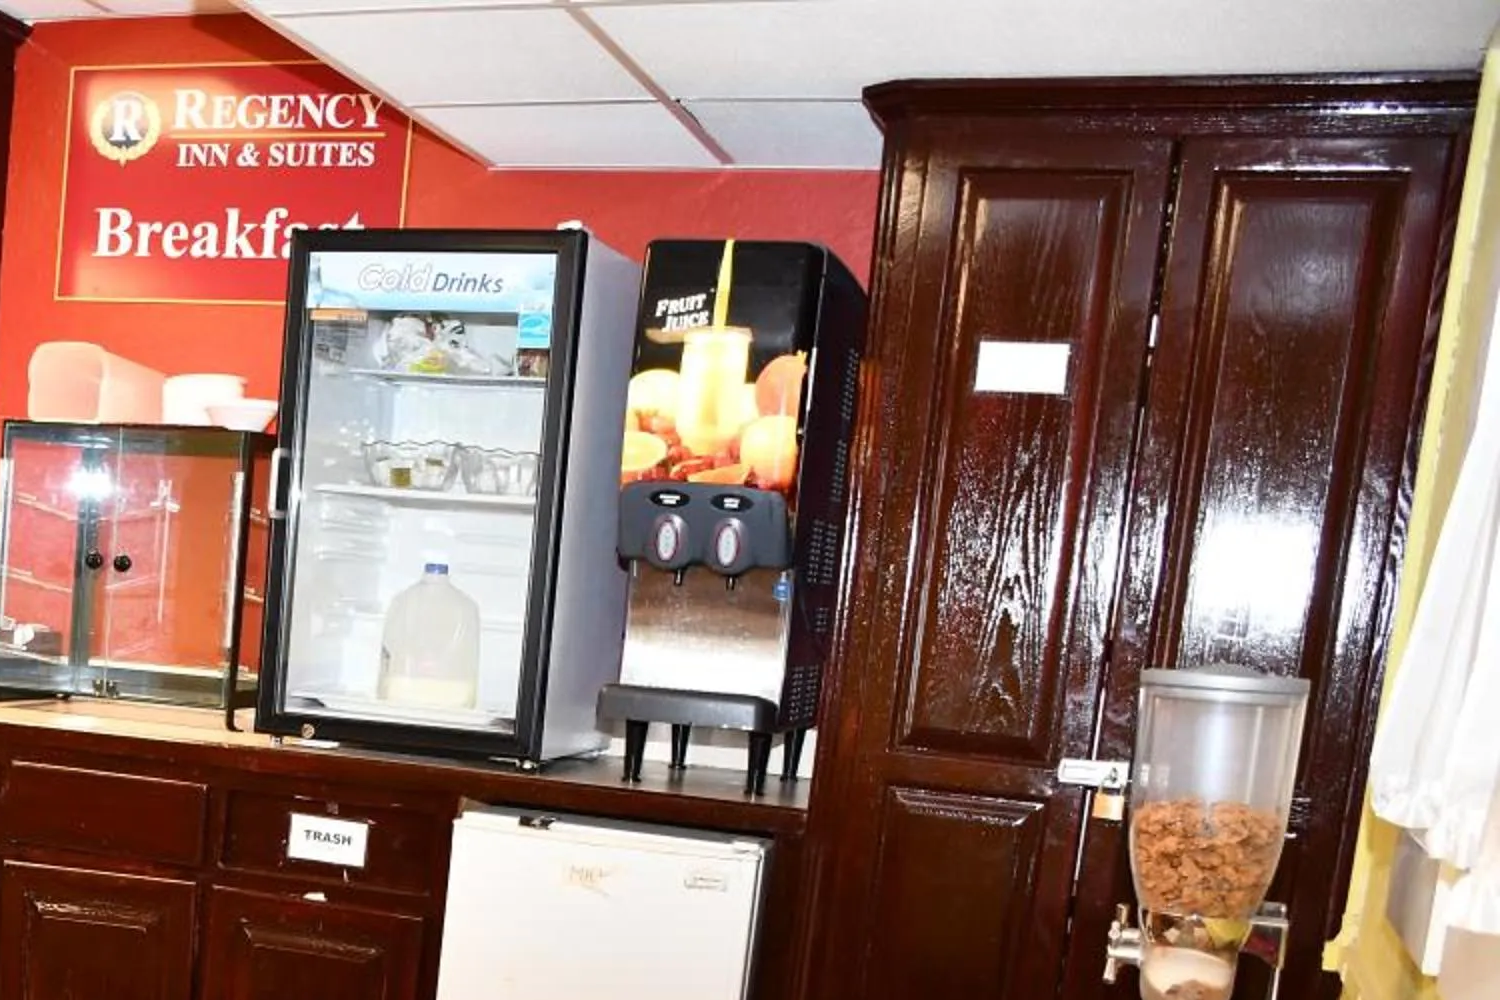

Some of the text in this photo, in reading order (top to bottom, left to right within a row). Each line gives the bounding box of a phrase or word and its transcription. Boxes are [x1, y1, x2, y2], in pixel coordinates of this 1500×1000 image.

[109, 99, 144, 142] R
[172, 89, 384, 129] REGENCY
[176, 142, 375, 168] INN & SUITES
[92, 207, 365, 259] Breakf
[358, 262, 503, 294] Cold Drinks
[655, 293, 707, 317] FRUIT
[661, 310, 709, 333] JUICE
[303, 829, 352, 846] TRASH
